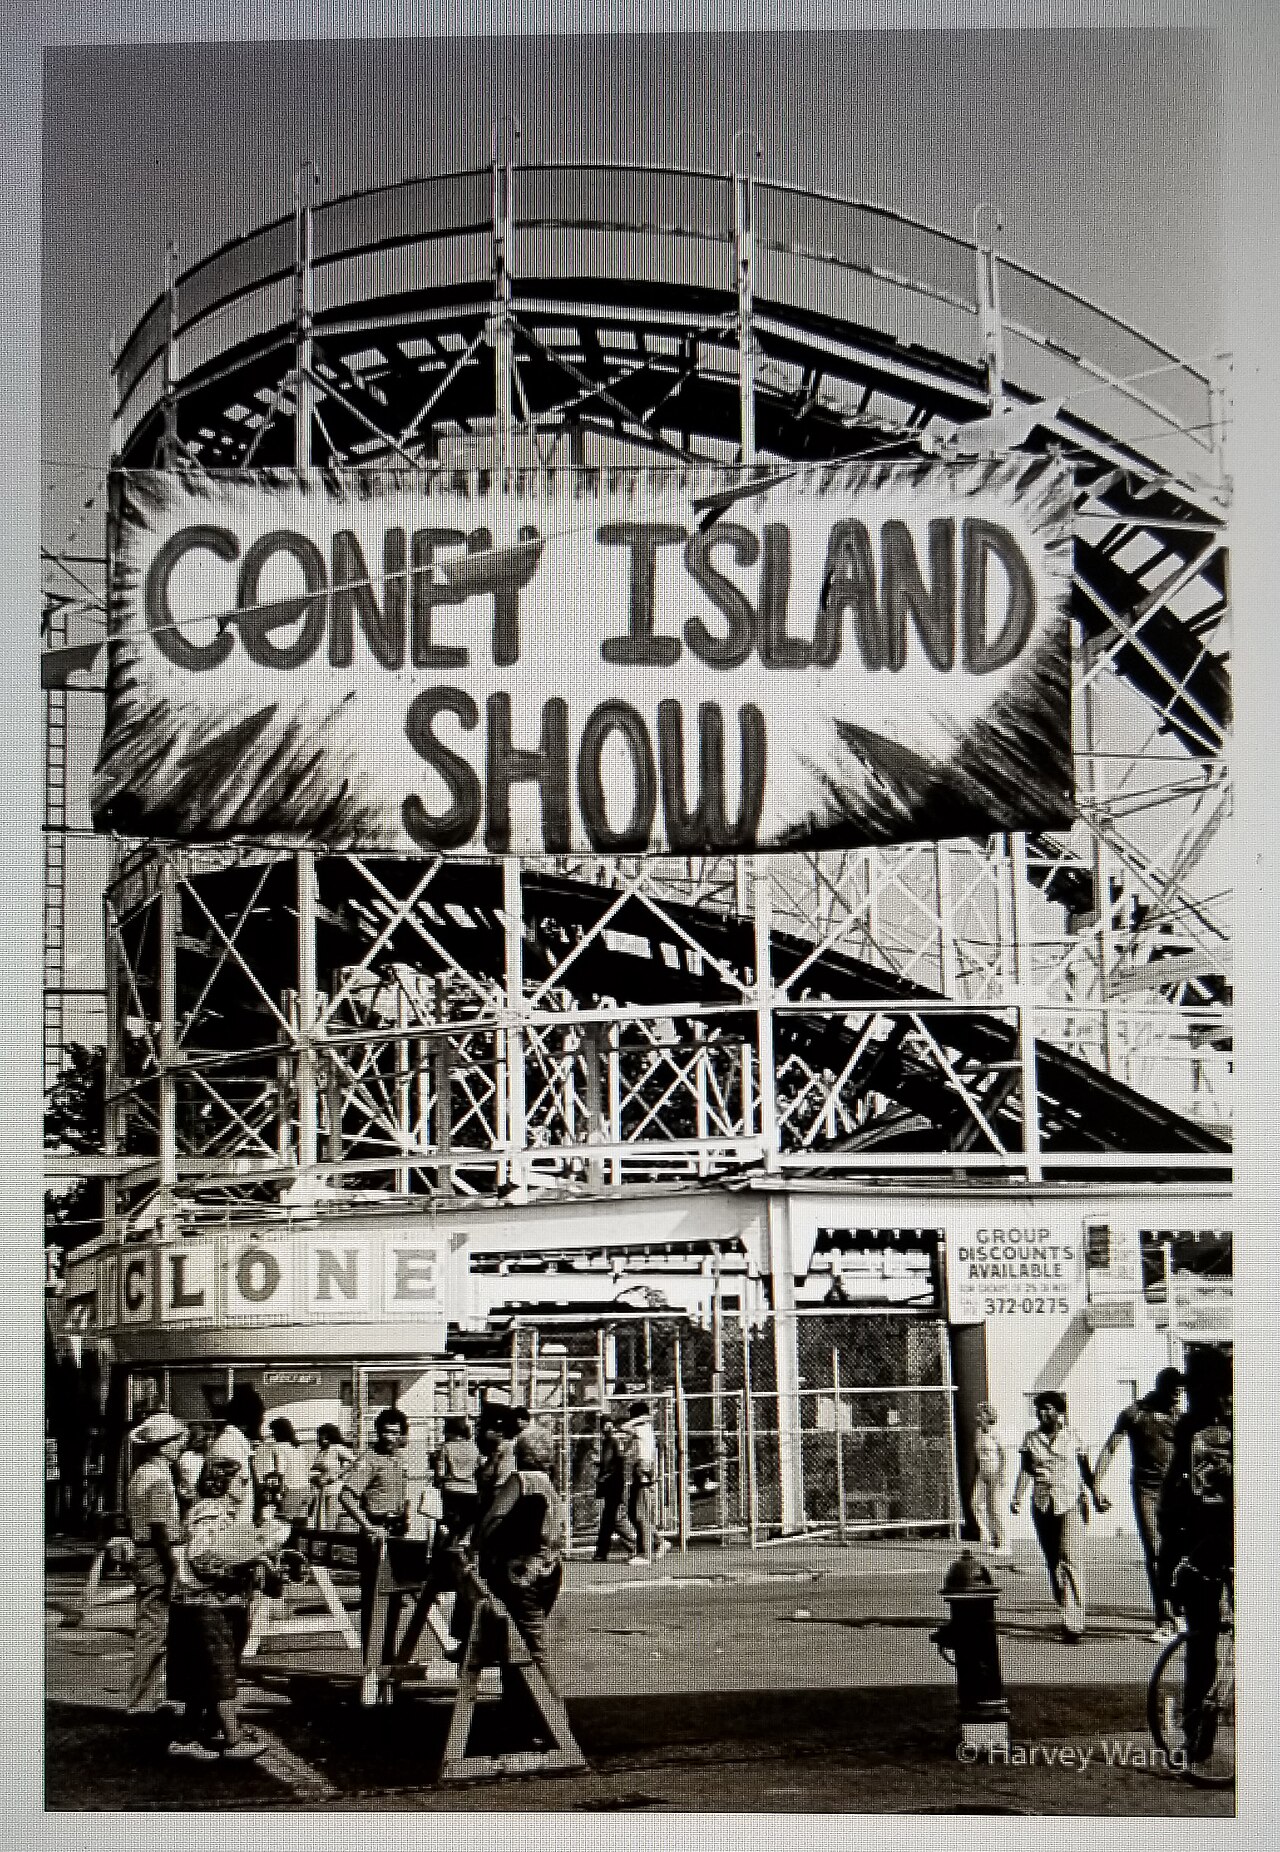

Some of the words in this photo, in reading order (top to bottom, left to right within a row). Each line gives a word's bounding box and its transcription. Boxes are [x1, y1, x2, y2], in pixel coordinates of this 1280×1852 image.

[145, 523, 540, 670] CONEY
[598, 517, 1035, 675] ISLAND
[401, 686, 768, 855] SHOW
[976, 1228, 1051, 1244] GROUP
[958, 1246, 1074, 1261] DISCOUNTS
[969, 1263, 1064, 1278] AVAILABLE
[985, 1297, 1070, 1315] 372-0275
